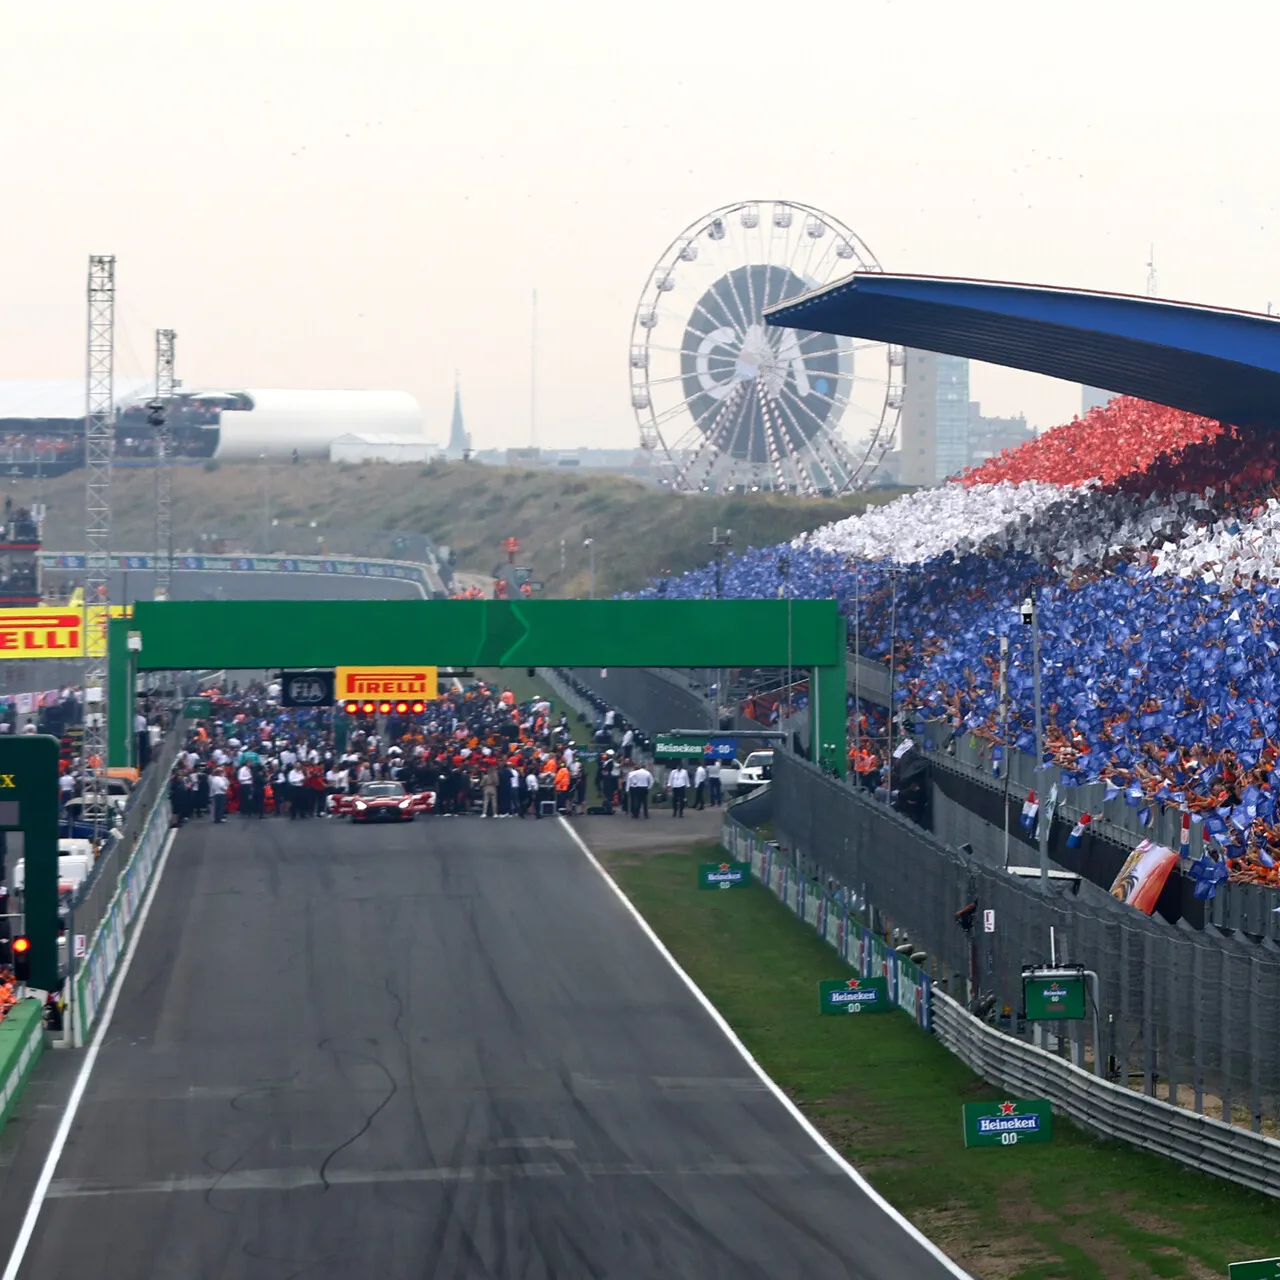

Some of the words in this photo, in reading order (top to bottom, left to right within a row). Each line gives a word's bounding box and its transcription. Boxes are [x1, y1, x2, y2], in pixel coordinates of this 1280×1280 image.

[291, 682, 322, 697] FIA
[346, 673, 427, 694] PIRELLI
[656, 743, 702, 753] Heineken
[832, 991, 875, 1001] Heineken
[981, 1117, 1036, 1131] Heineken
